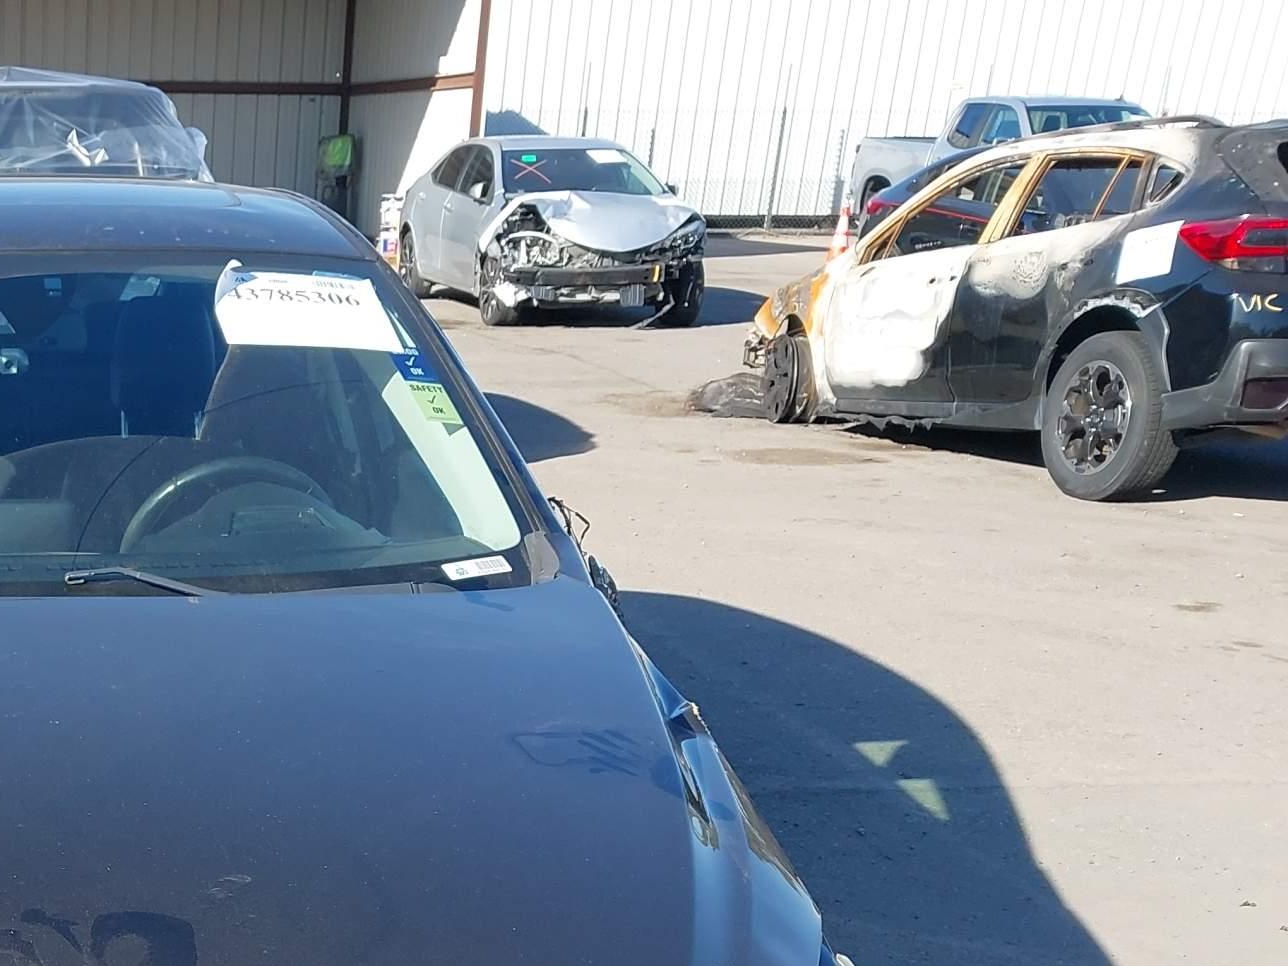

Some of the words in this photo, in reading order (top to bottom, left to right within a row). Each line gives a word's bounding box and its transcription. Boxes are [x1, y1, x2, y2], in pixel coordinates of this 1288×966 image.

[227, 287, 361, 307] 43785306
[1238, 293, 1283, 312] VIC
[410, 367, 425, 376] OK
[409, 384, 444, 394] SAFETY
[432, 406, 446, 415] OK
